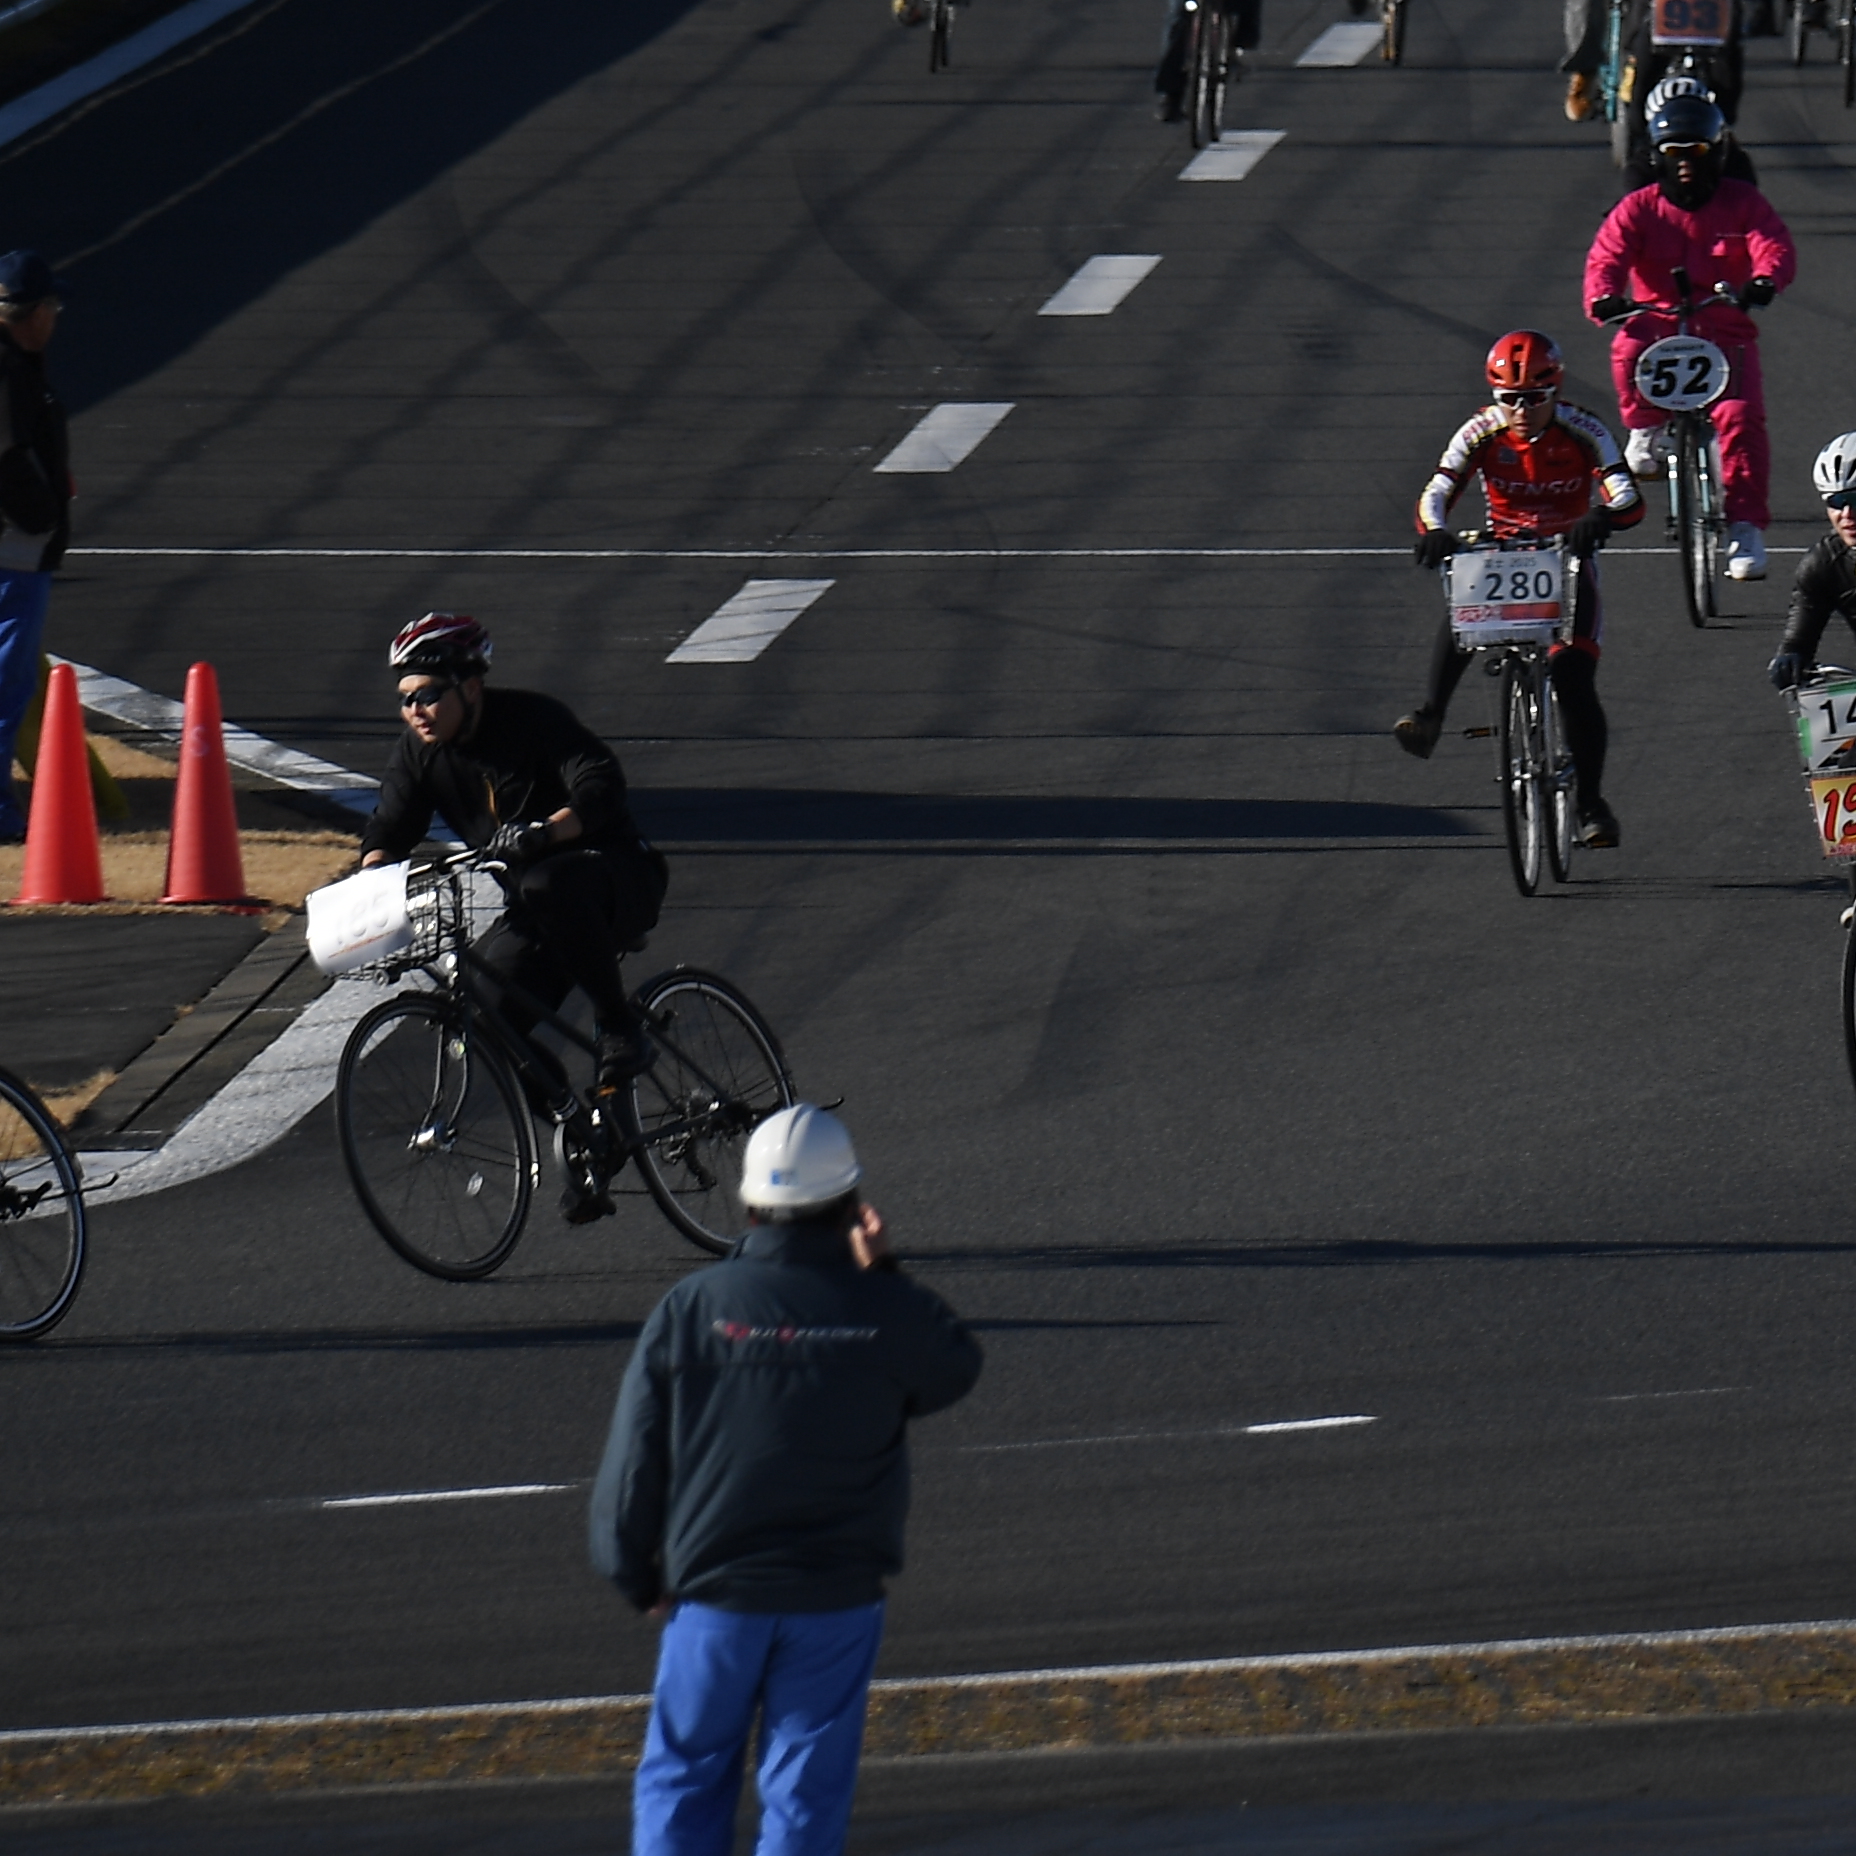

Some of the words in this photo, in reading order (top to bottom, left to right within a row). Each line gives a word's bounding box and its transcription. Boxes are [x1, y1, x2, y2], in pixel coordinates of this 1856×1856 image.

[1650, 355, 1713, 398] 52
[1490, 475, 1583, 498] DENSO
[1484, 570, 1554, 602] 280
